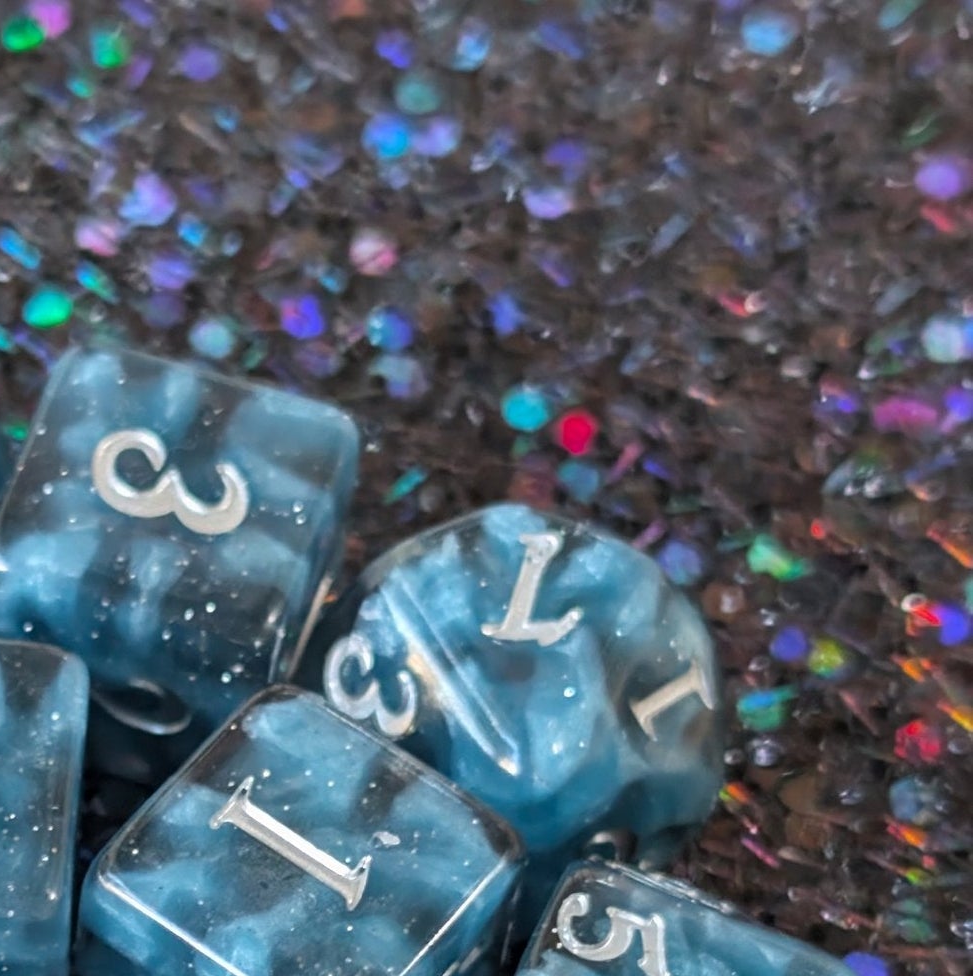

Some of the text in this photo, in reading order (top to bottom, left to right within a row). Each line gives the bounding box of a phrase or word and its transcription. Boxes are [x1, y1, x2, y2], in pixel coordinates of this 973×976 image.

[92, 427, 249, 535] 3
[324, 633, 418, 738] 3
[209, 775, 373, 912] 1
